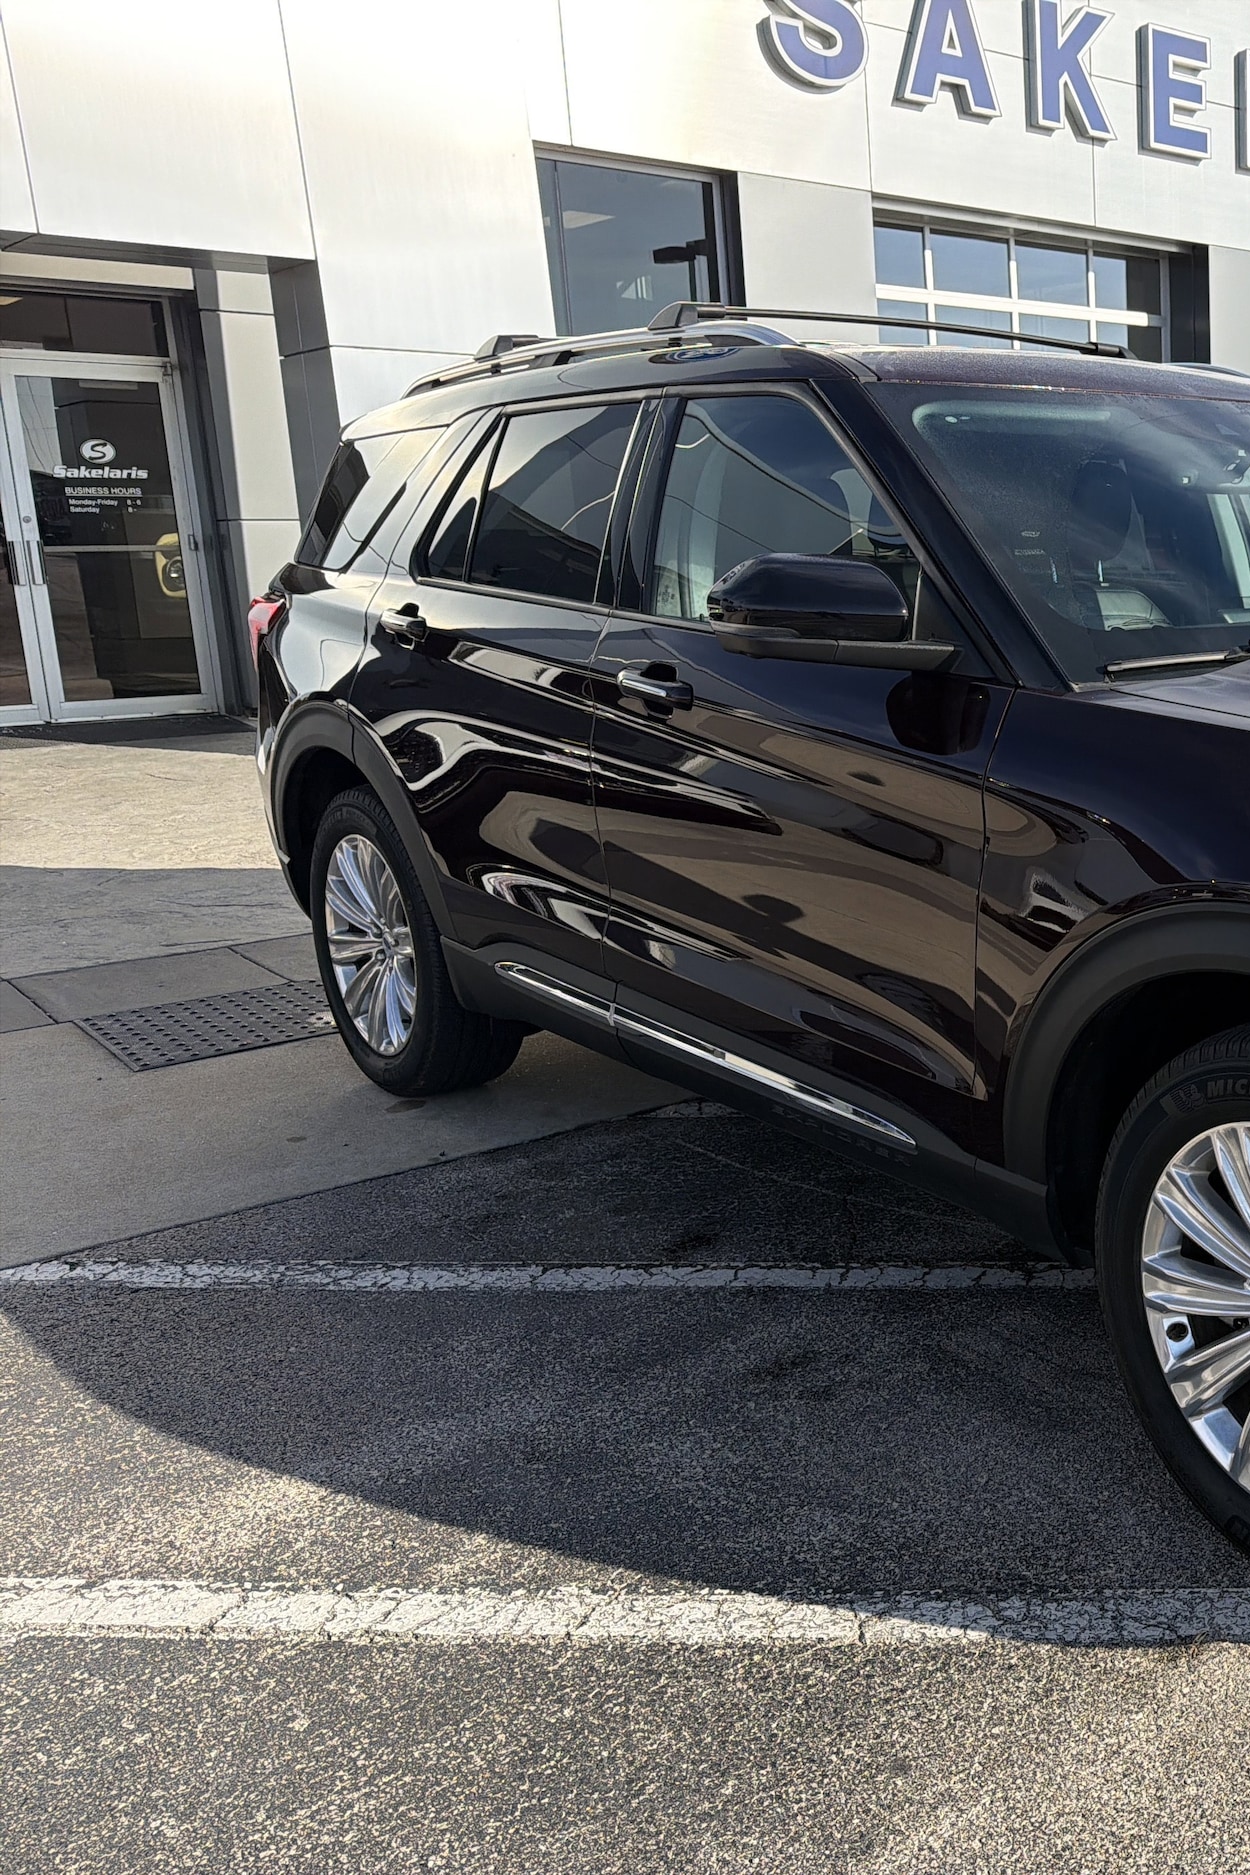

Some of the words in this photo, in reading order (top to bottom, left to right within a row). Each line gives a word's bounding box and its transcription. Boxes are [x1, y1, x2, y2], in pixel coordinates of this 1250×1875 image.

[53, 465, 149, 479] Sakelaris
[64, 486, 110, 495] BUSINESS
[110, 487, 142, 496] HOURS
[68, 498, 119, 507] Monday-Friday
[69, 506, 100, 514] Saturday
